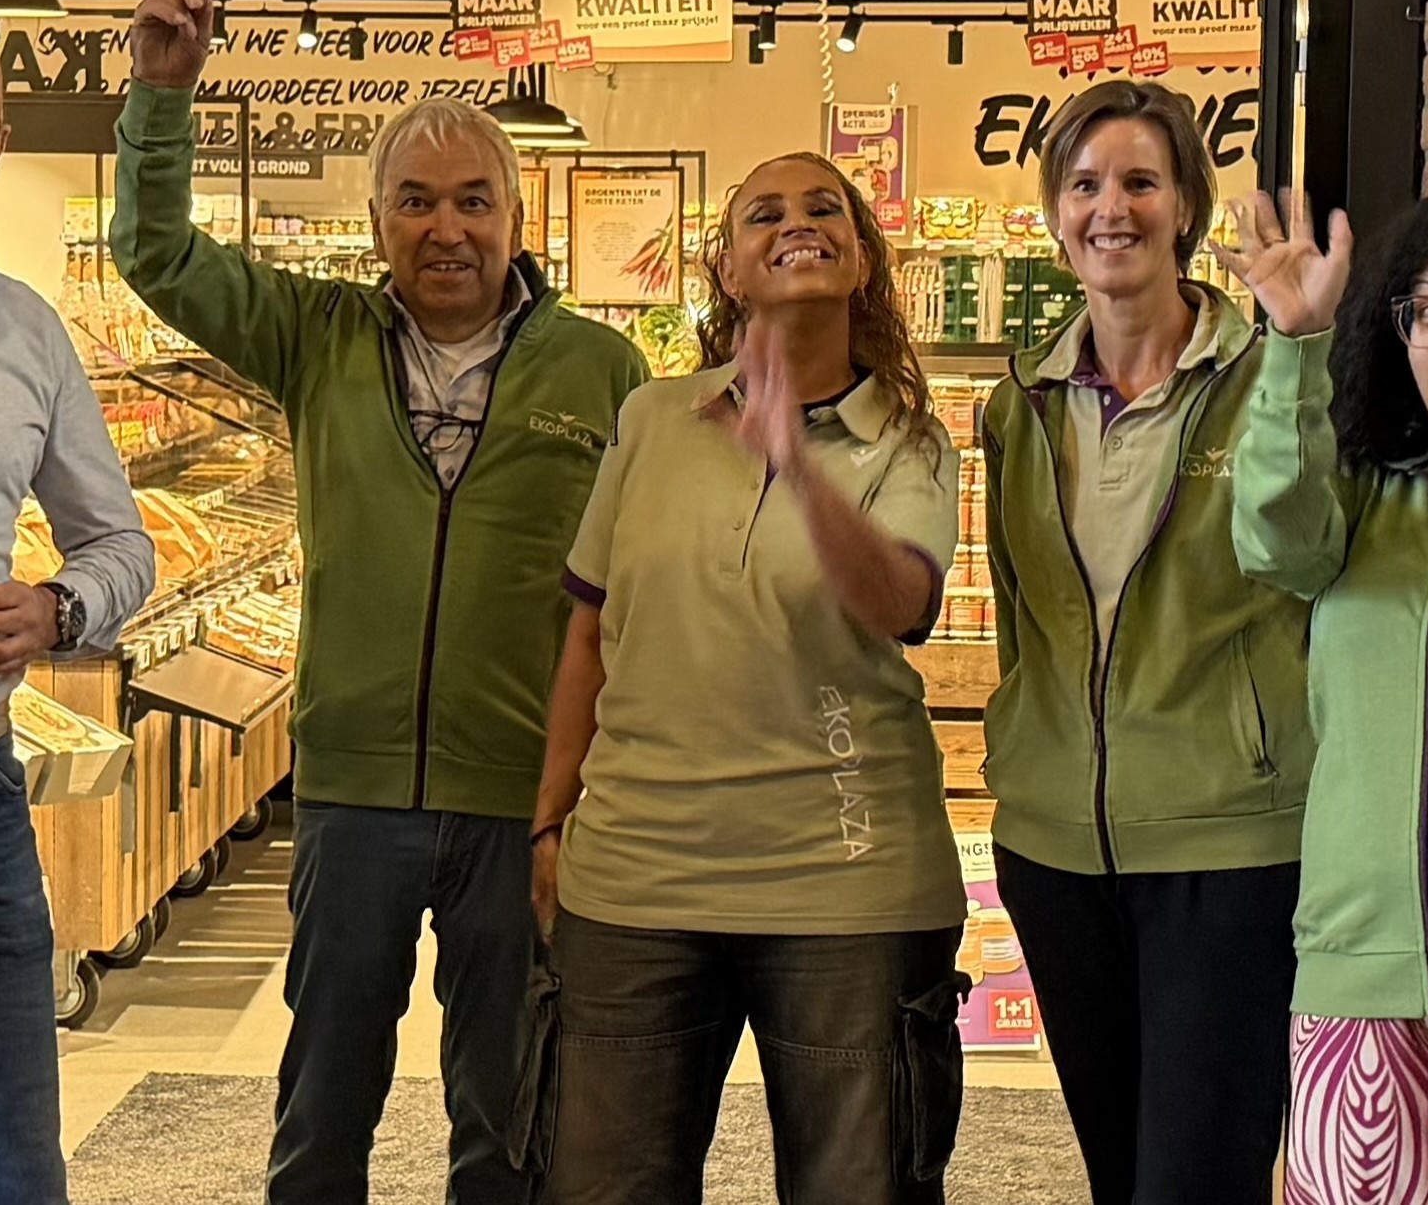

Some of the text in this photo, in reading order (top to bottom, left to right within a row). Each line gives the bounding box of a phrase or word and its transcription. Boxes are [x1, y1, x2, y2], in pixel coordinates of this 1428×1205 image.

[458, 13, 536, 27] PRIJSWEKEN
[576, 22, 600, 31] voor
[1033, 19, 1112, 33] PRIJSWEKEN
[244, 28, 289, 57] WE
[373, 30, 434, 57] VOOR
[226, 78, 344, 106] VOORDEEL
[349, 79, 410, 105] VOOR
[257, 160, 311, 175] GROND
[993, 996, 1033, 1019] 1+1
